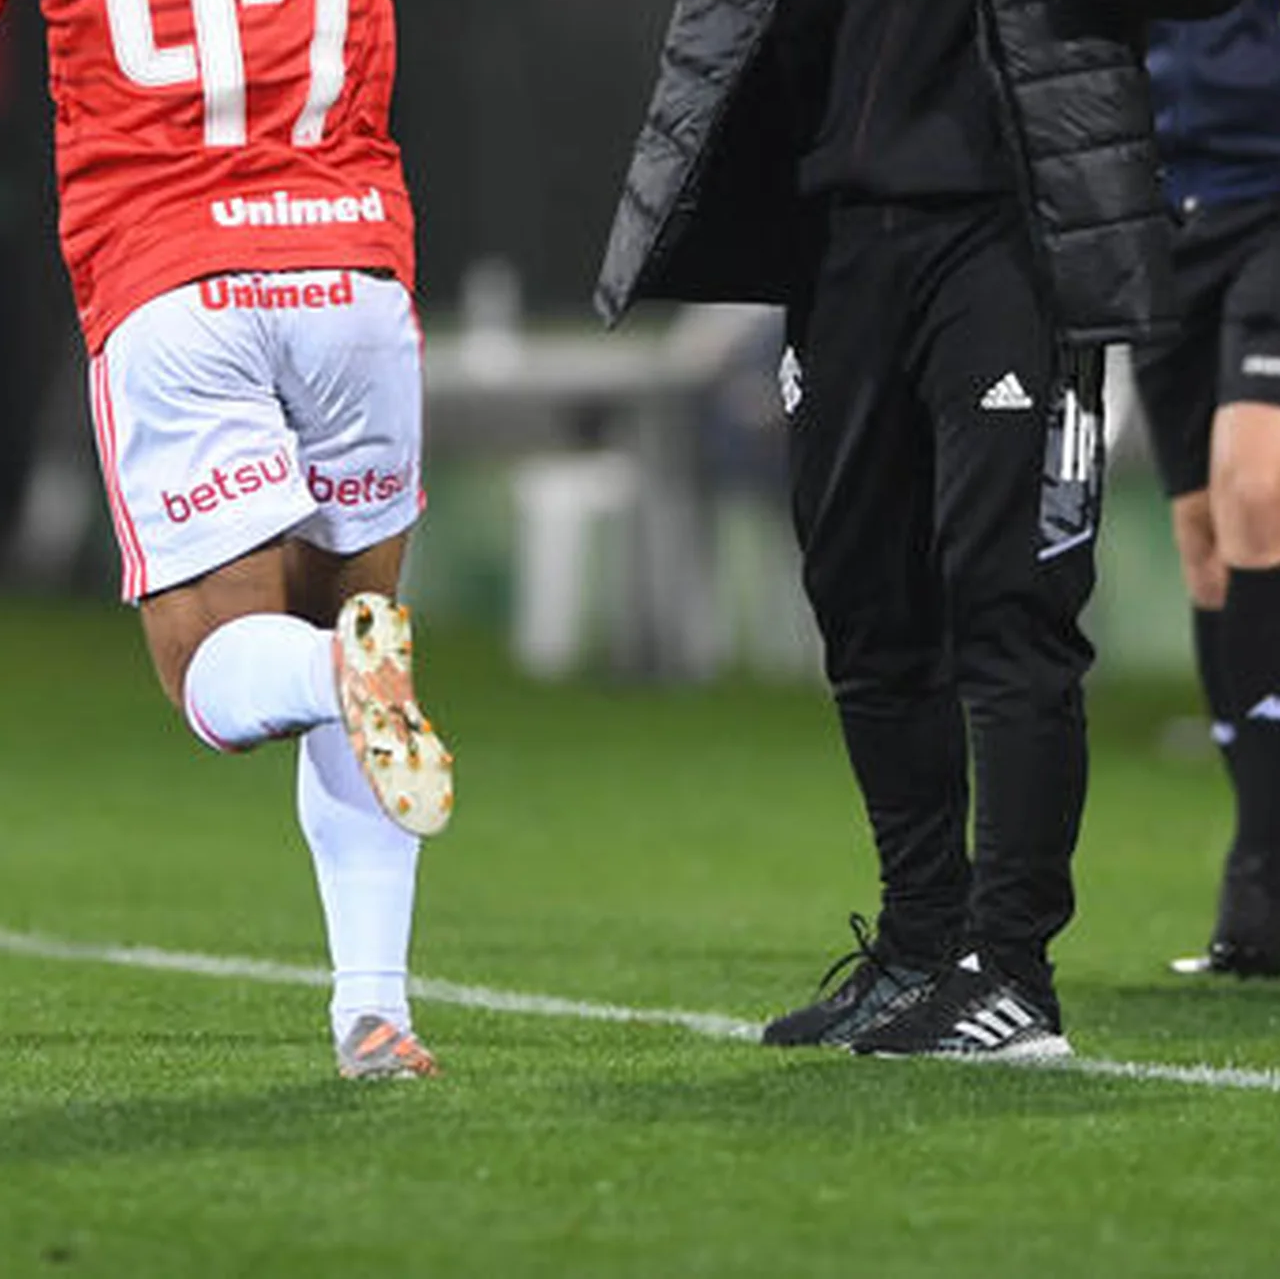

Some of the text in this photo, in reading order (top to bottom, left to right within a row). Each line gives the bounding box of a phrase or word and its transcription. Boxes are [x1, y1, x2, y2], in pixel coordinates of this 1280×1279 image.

[211, 187, 384, 227] Unimed
[199, 271, 353, 310] Unimed
[307, 464, 410, 506] bets
